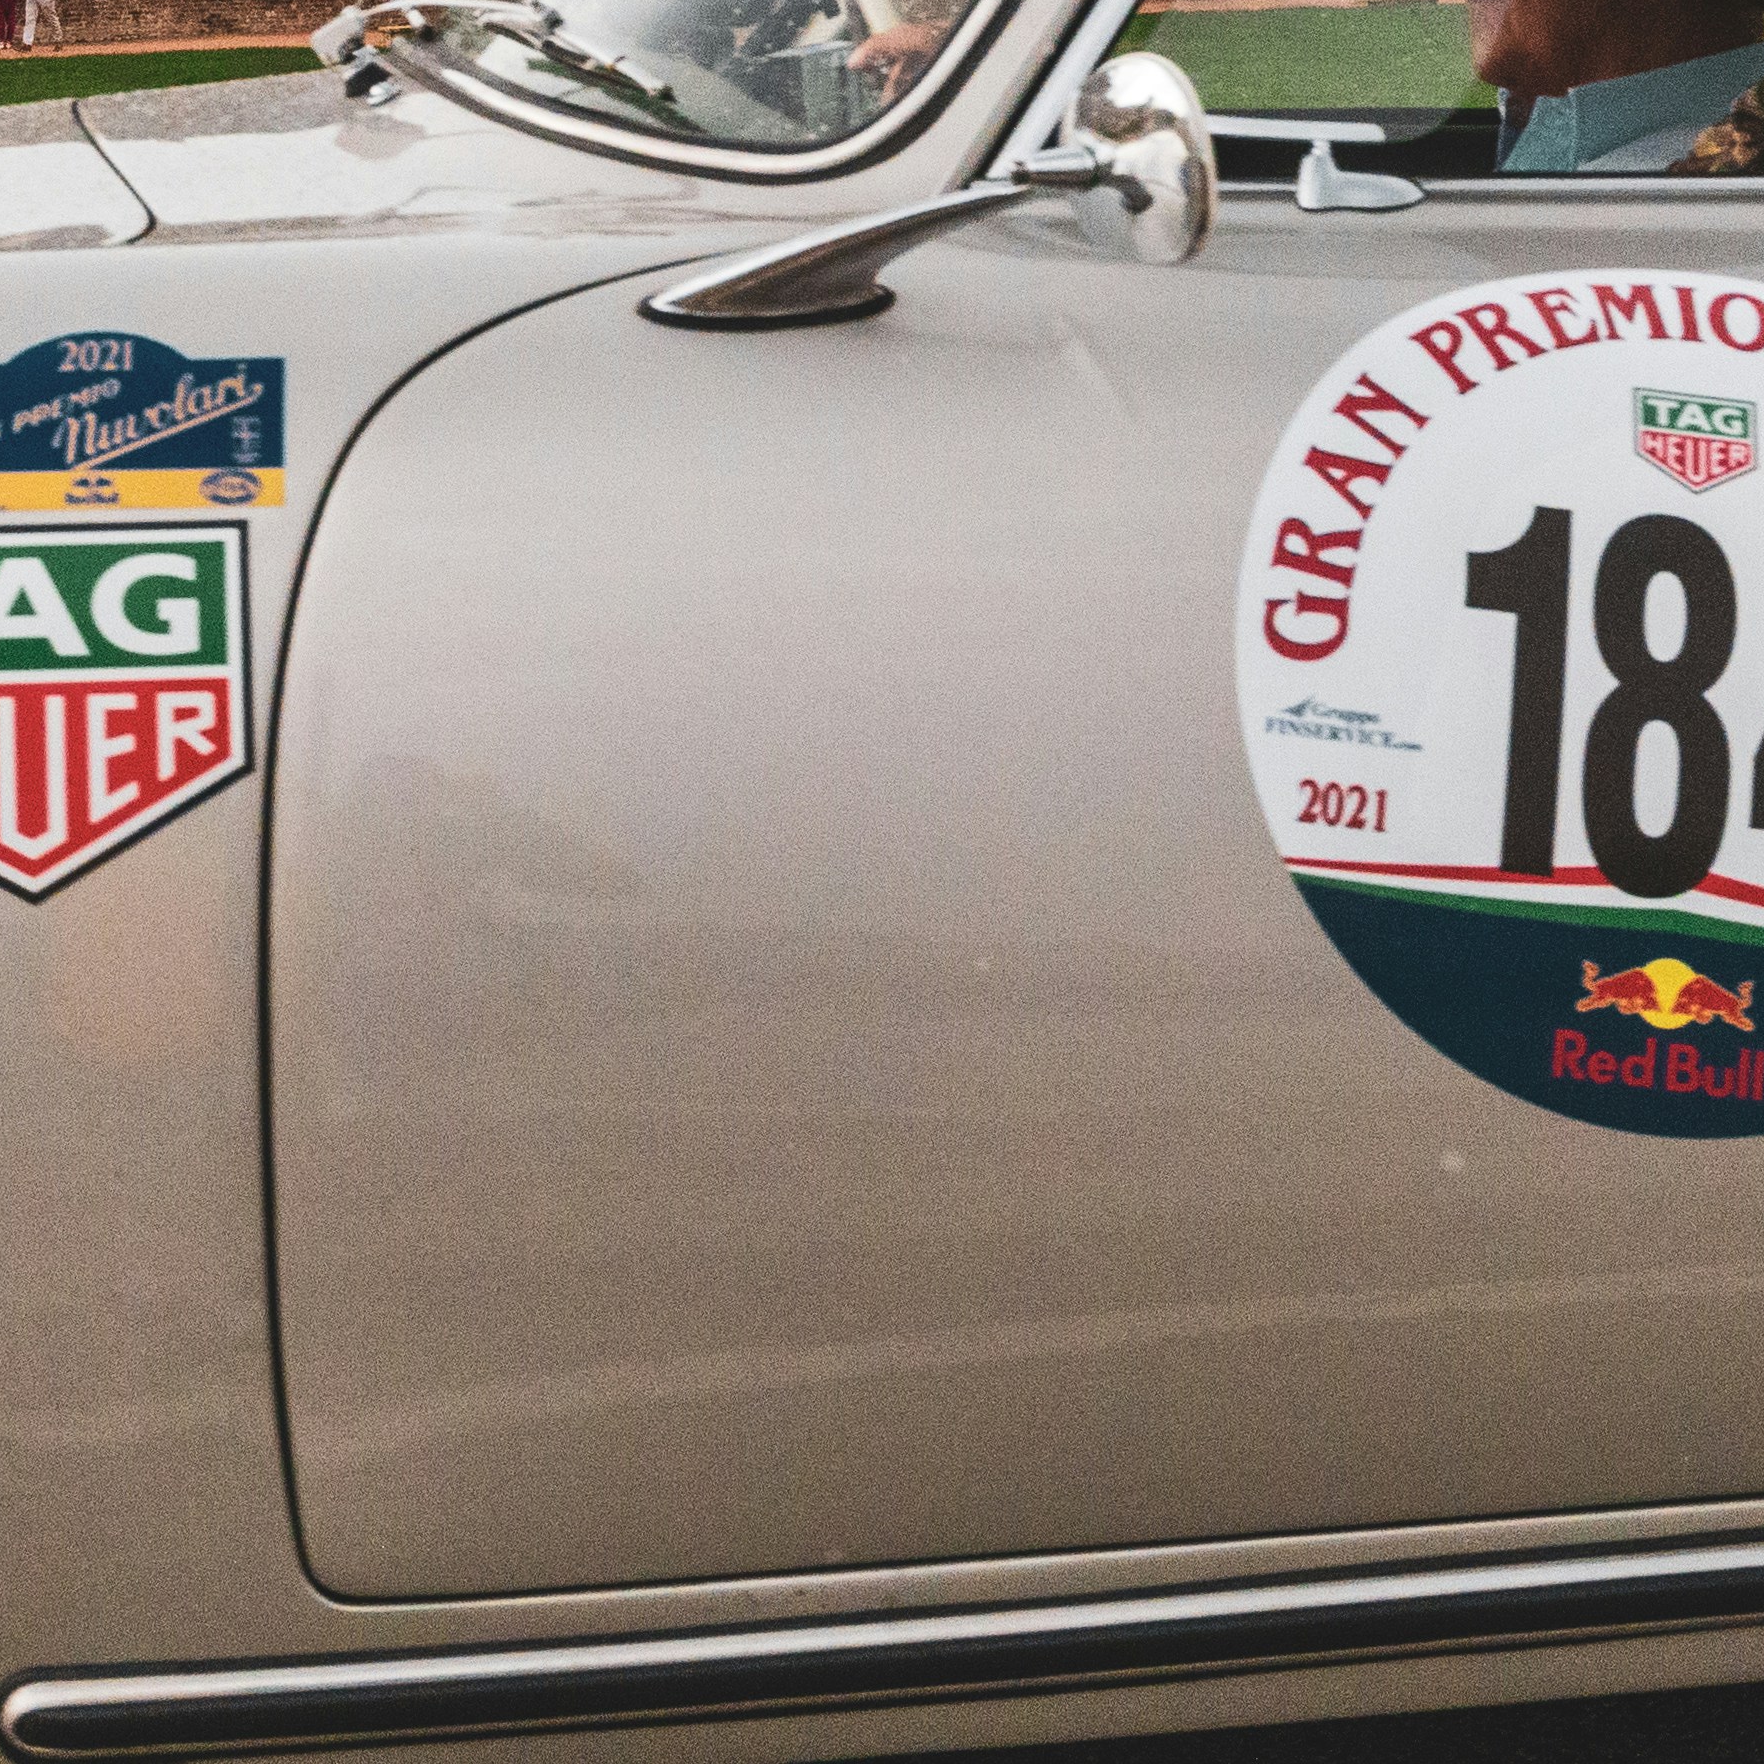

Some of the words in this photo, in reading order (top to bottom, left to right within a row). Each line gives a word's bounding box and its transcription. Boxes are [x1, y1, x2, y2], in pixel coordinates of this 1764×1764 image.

[57, 340, 133, 372] 2021
[51, 362, 251, 466] Nuvolari
[1646, 397, 1745, 436] TAG
[1642, 432, 1751, 482] HEUER
[1263, 375, 1429, 663] GRAN
[1297, 777, 1388, 832] 2021
[1551, 1027, 1658, 1089] Red
